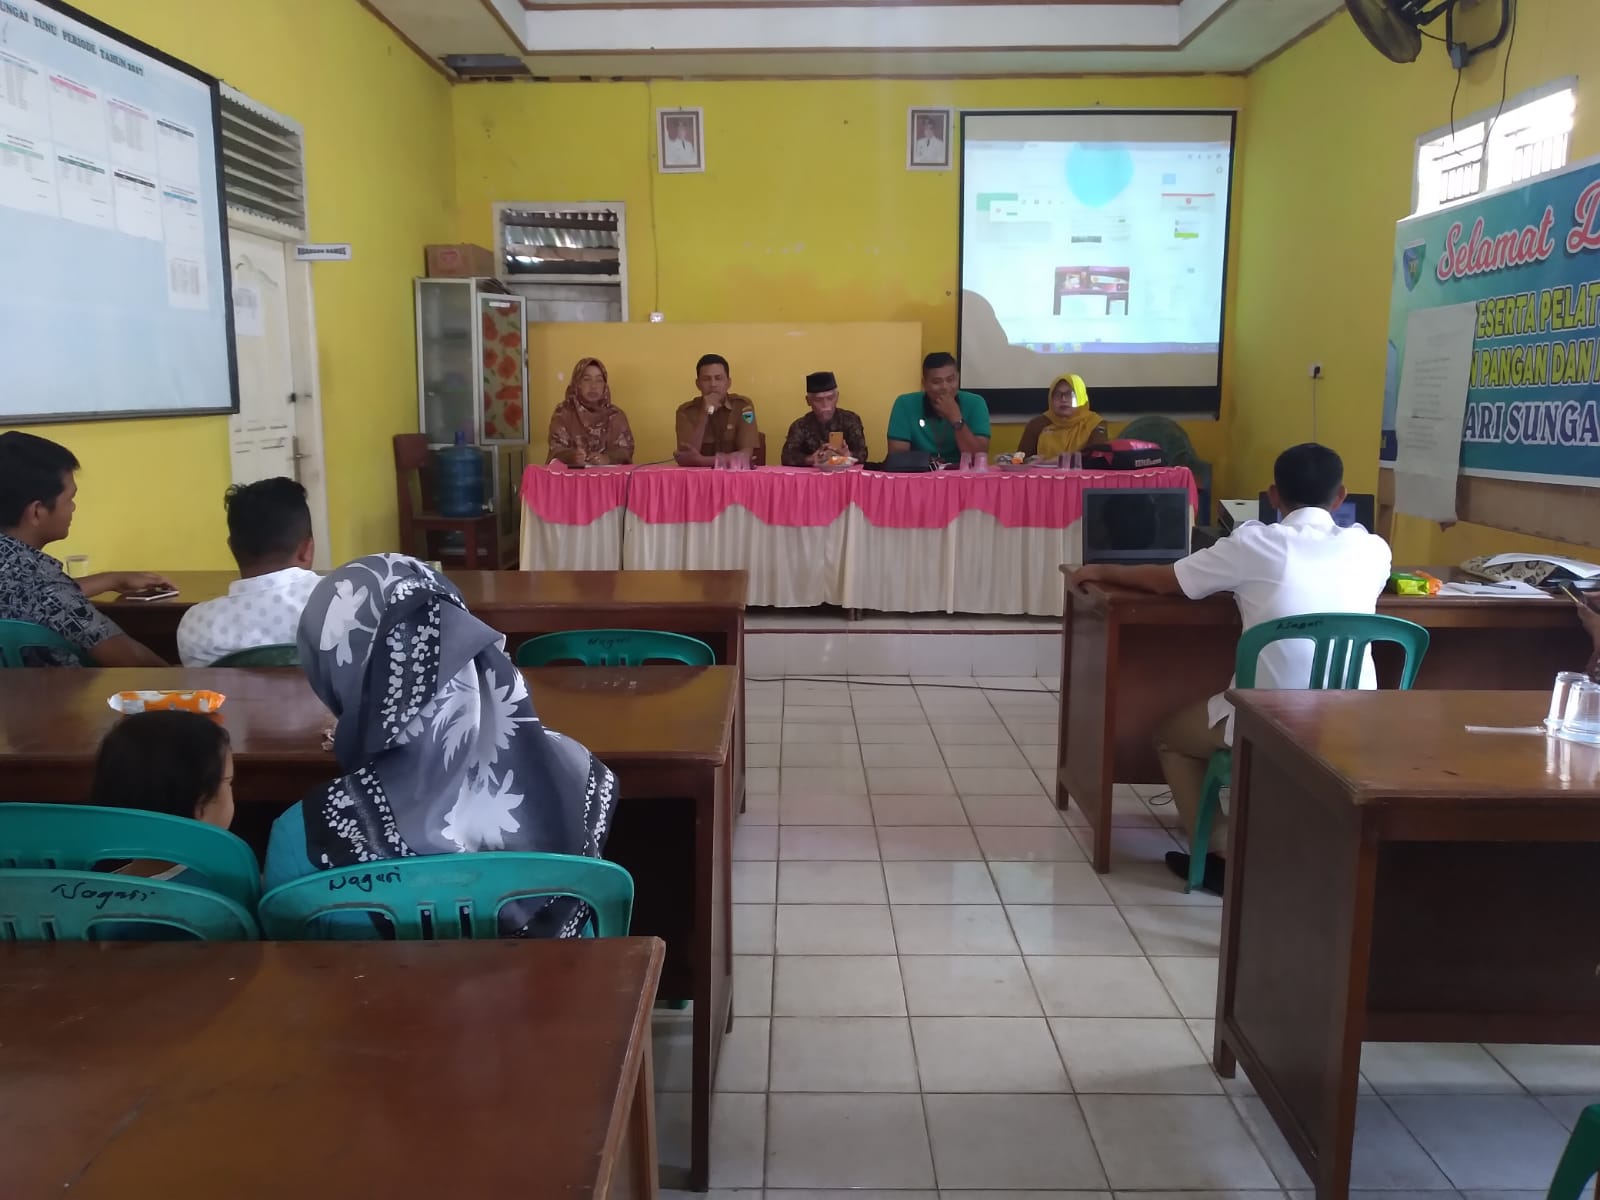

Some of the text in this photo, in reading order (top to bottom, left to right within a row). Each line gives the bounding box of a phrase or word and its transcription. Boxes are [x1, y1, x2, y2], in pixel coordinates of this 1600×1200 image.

[1437, 205, 1555, 281] Selamat
[1475, 290, 1538, 341] ESERTA
[1480, 341, 1550, 389] PANGAN
[1550, 337, 1596, 386] DAN
[1463, 402, 1506, 443] ARI
